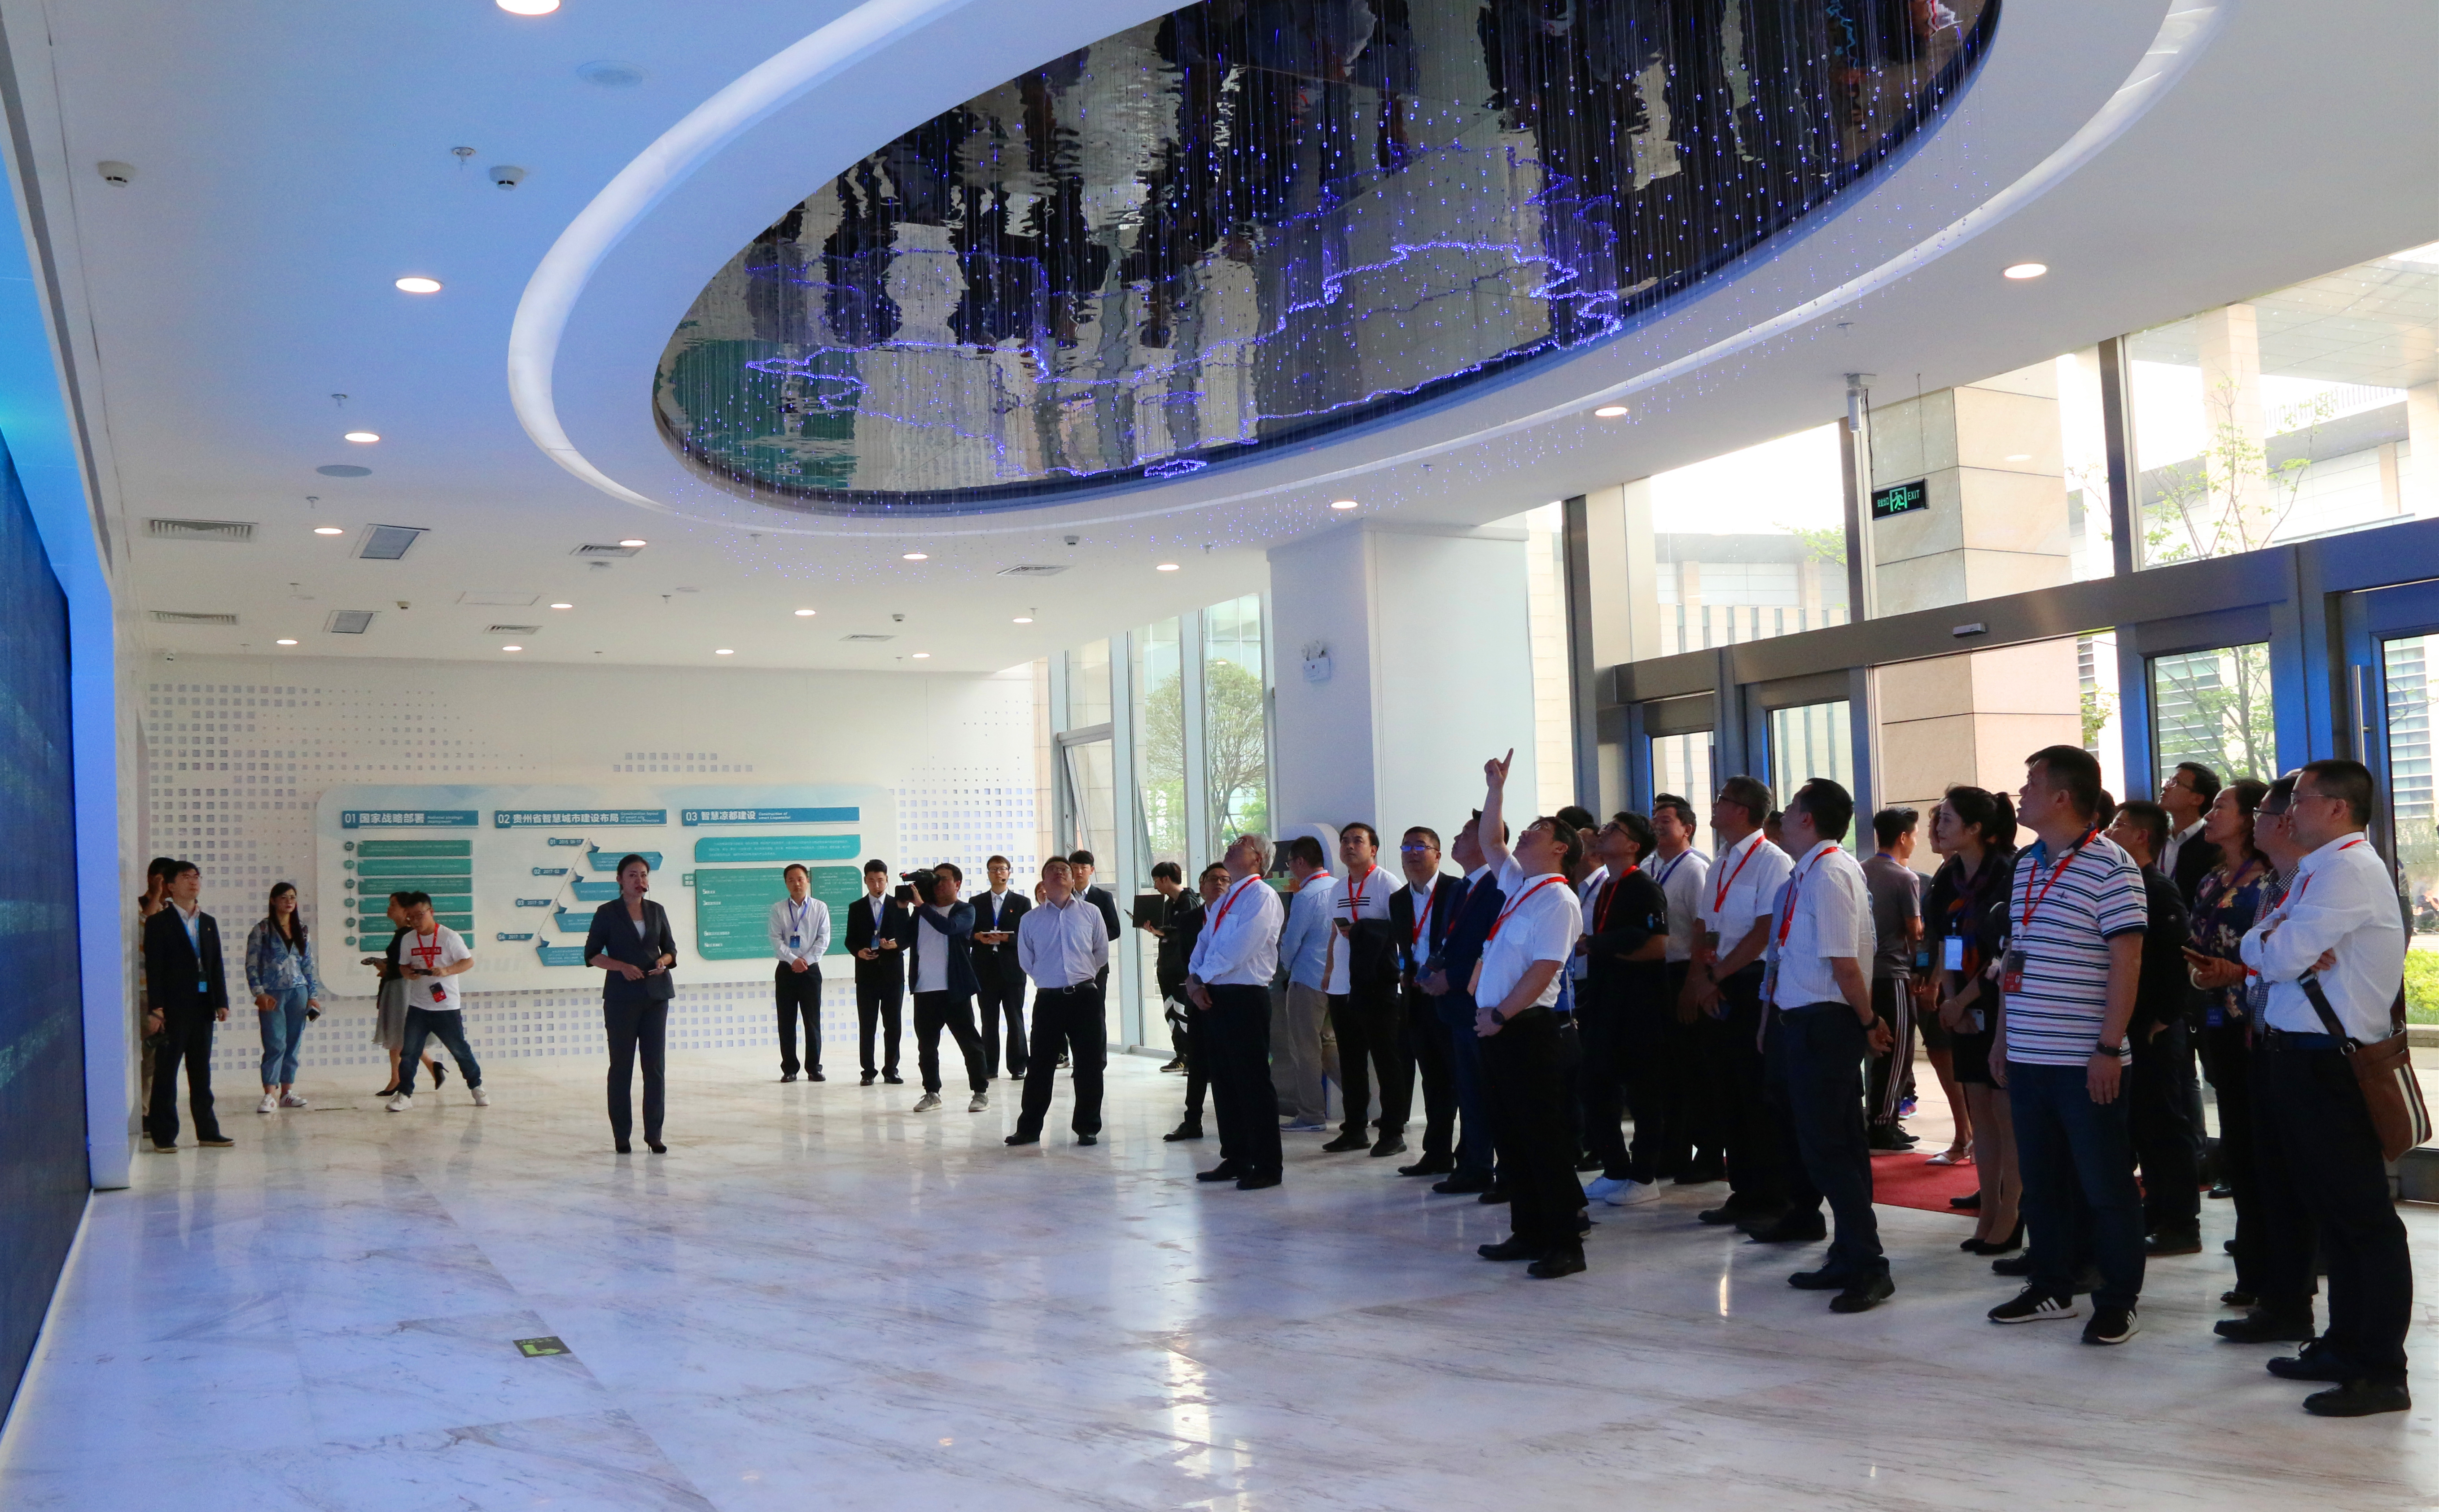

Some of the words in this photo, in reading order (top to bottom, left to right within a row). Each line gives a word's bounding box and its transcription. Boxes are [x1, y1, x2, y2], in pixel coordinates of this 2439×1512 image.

[1908, 489, 1920, 500] EXIT
[345, 813, 356, 823] 01
[359, 813, 425, 824] 国家战略部署
[498, 814, 510, 824] 02
[512, 813, 619, 823] 贵州省智慧城市建设布局
[686, 812, 697, 821] 03
[701, 811, 756, 821] 智慧凉都建设
